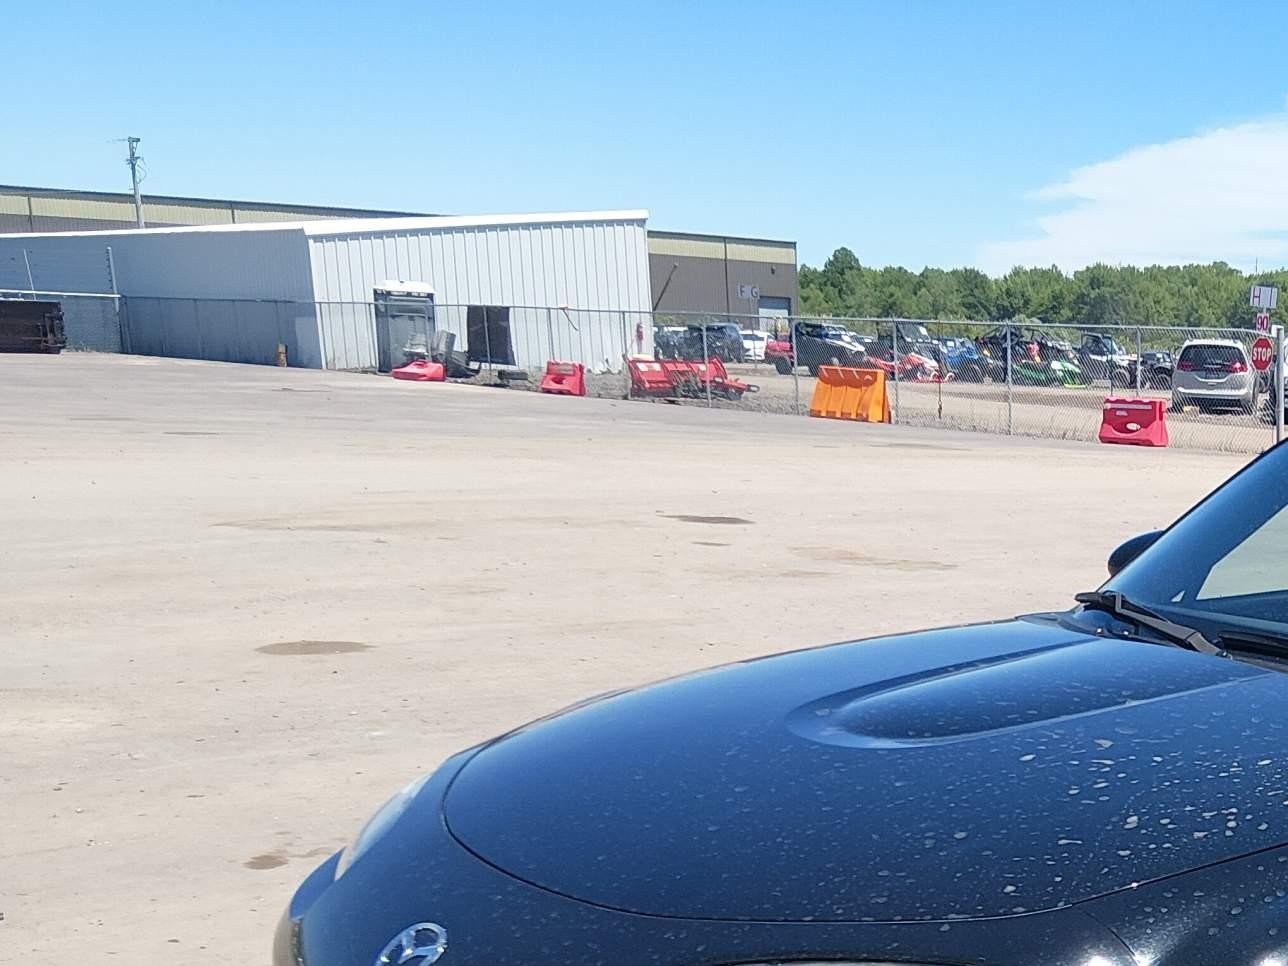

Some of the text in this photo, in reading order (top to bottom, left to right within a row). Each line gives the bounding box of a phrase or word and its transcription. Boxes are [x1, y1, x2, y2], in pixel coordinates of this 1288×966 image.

[750, 286, 759, 298] G
[1253, 287, 1262, 305] H
[1257, 316, 1269, 331] 90
[1253, 347, 1272, 361] STOP
